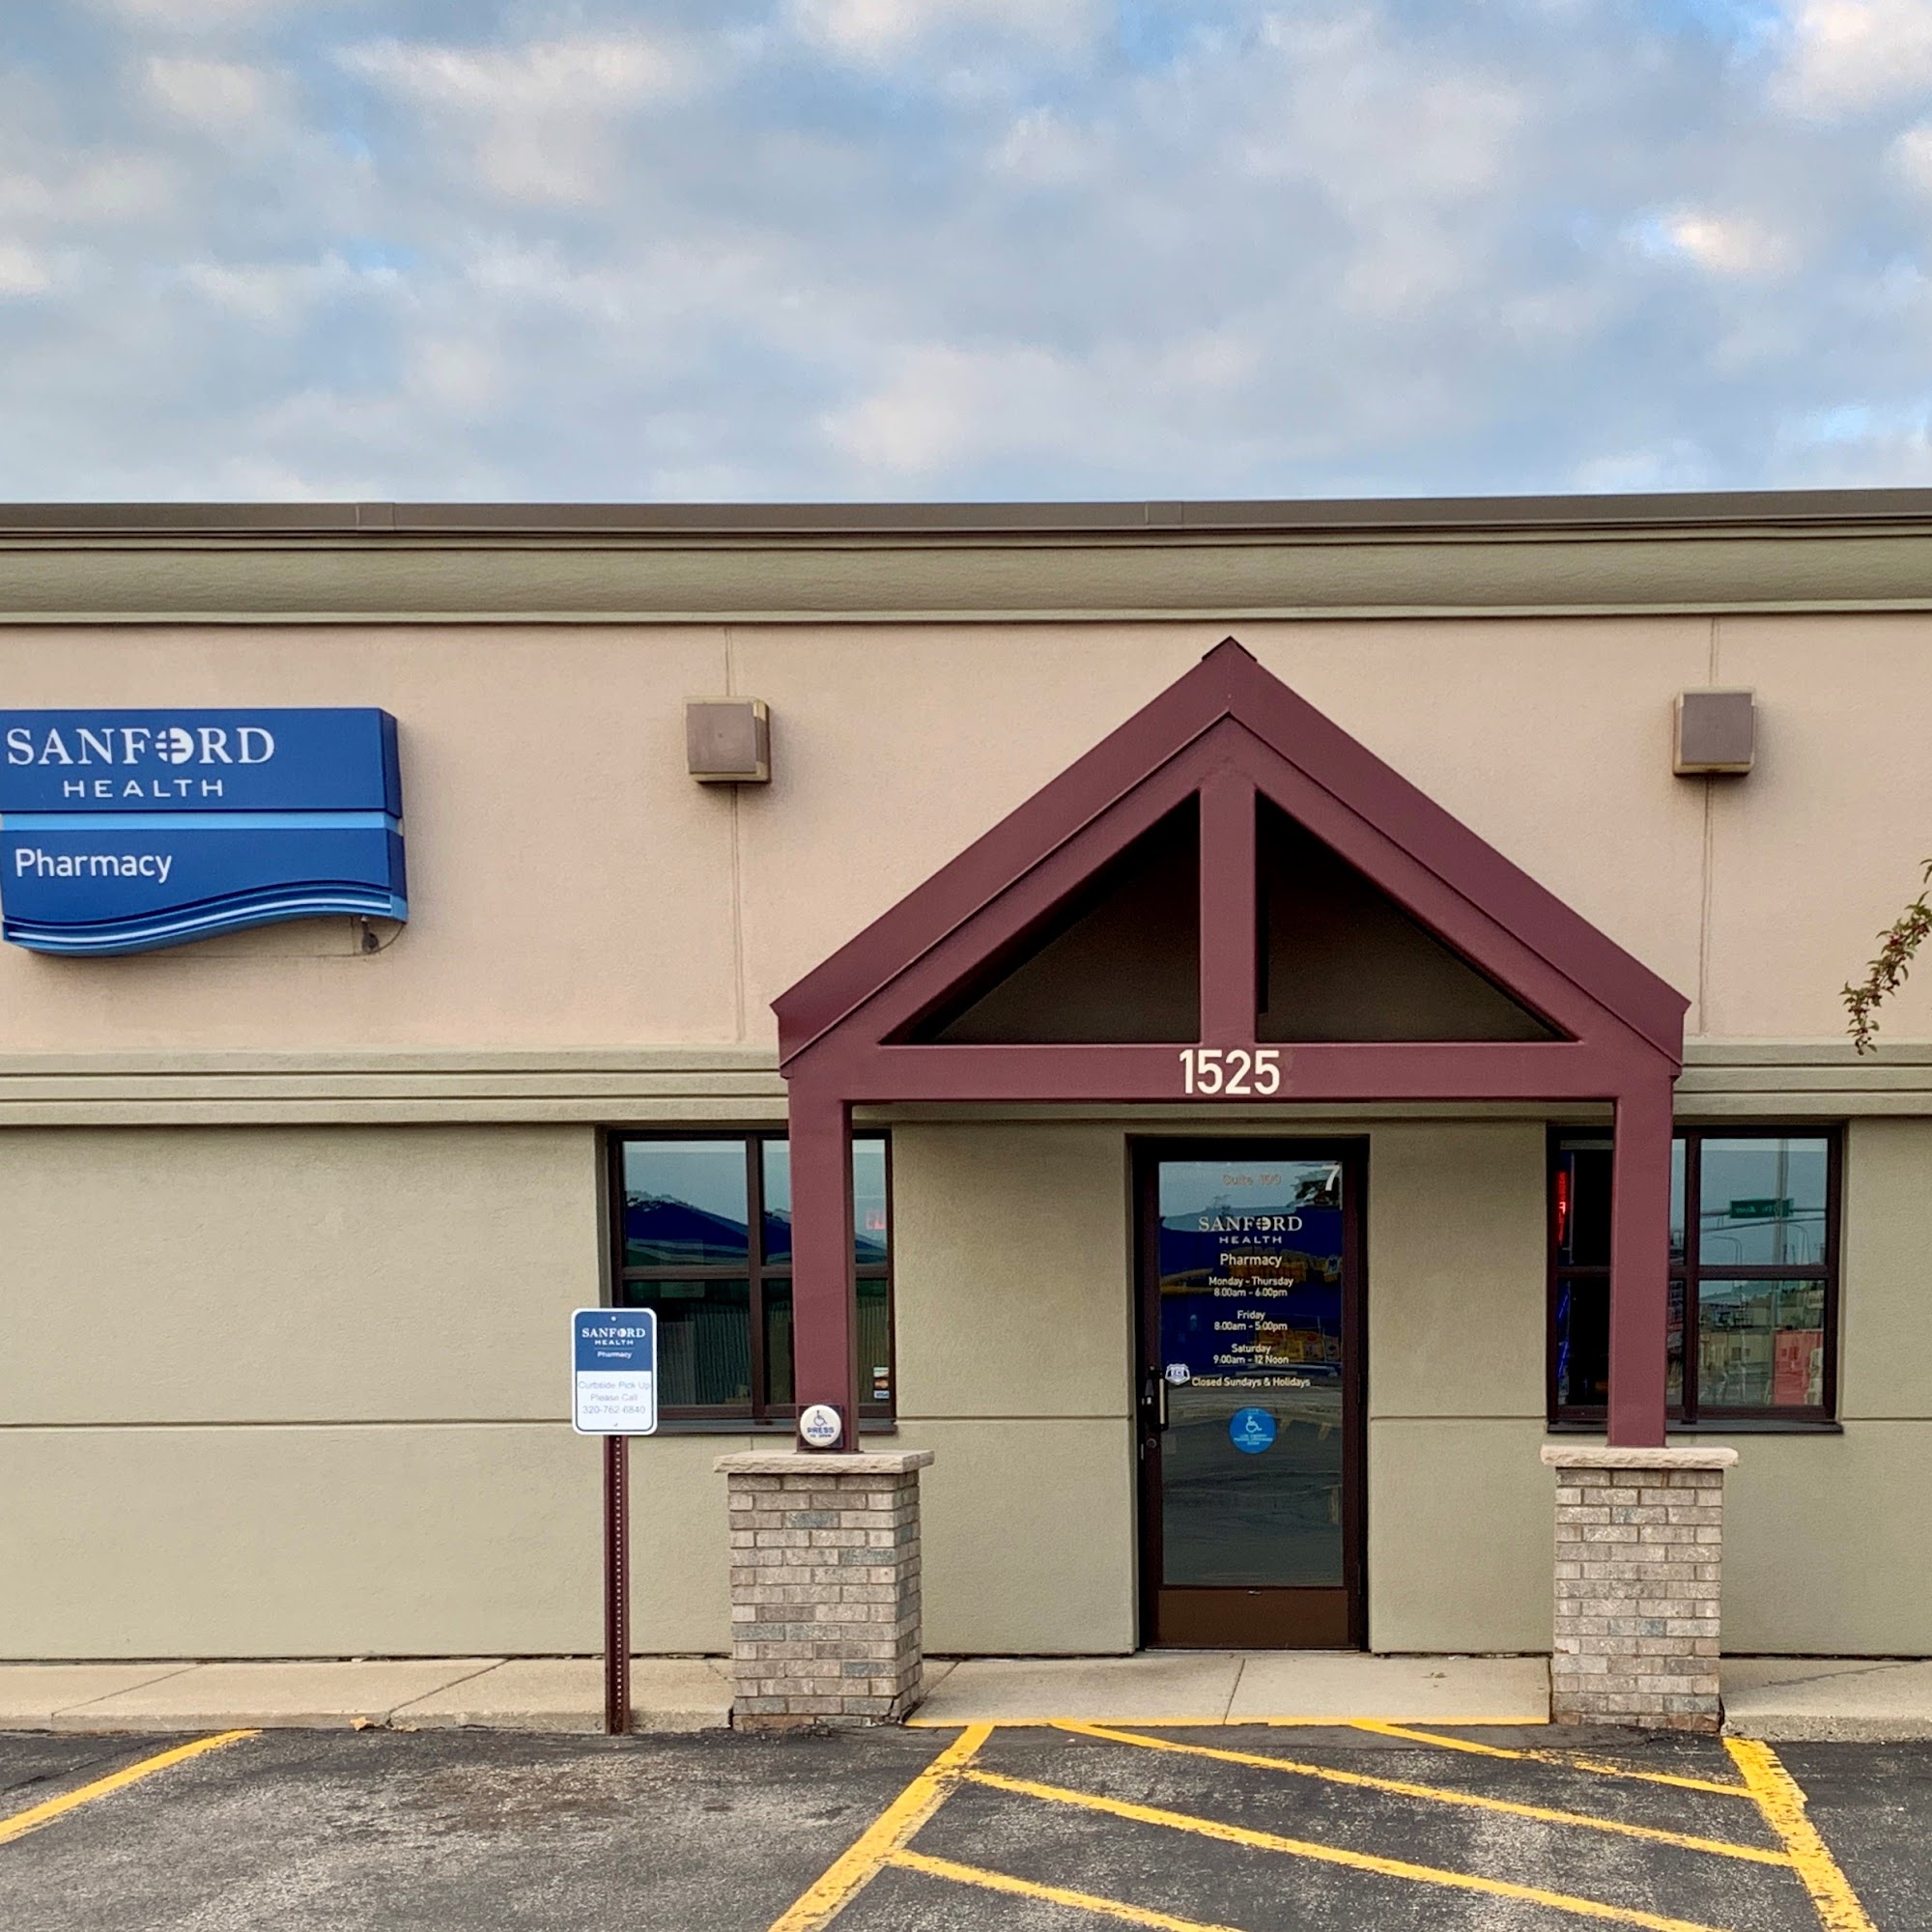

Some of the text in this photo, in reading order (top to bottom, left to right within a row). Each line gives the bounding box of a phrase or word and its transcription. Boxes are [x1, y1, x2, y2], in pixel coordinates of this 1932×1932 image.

[7, 727, 275, 766] SANFORD
[64, 779, 223, 798] HEALTH
[15, 848, 172, 884] Pharmacy
[1179, 1049, 1280, 1094] 1525
[1321, 1164, 1341, 1191] 7
[1199, 1215, 1303, 1232] SANFORD
[1219, 1236, 1283, 1244] HEALTH
[1219, 1253, 1283, 1268] Pharmacy
[1208, 1276, 1243, 1288] Monday
[1251, 1276, 1294, 1288] Thursday
[1236, 1310, 1266, 1321] Friday
[582, 1327, 646, 1338] SANFORD
[597, 1350, 634, 1359] Pharmacy
[1231, 1344, 1272, 1354] Saturday
[1264, 1354, 1290, 1364] Noon
[579, 1380, 616, 1389] Curbside
[618, 1380, 636, 1389] Pick
[1192, 1378, 1311, 1388] Closed Sundays & Holidays
[590, 1393, 638, 1402] Please Call
